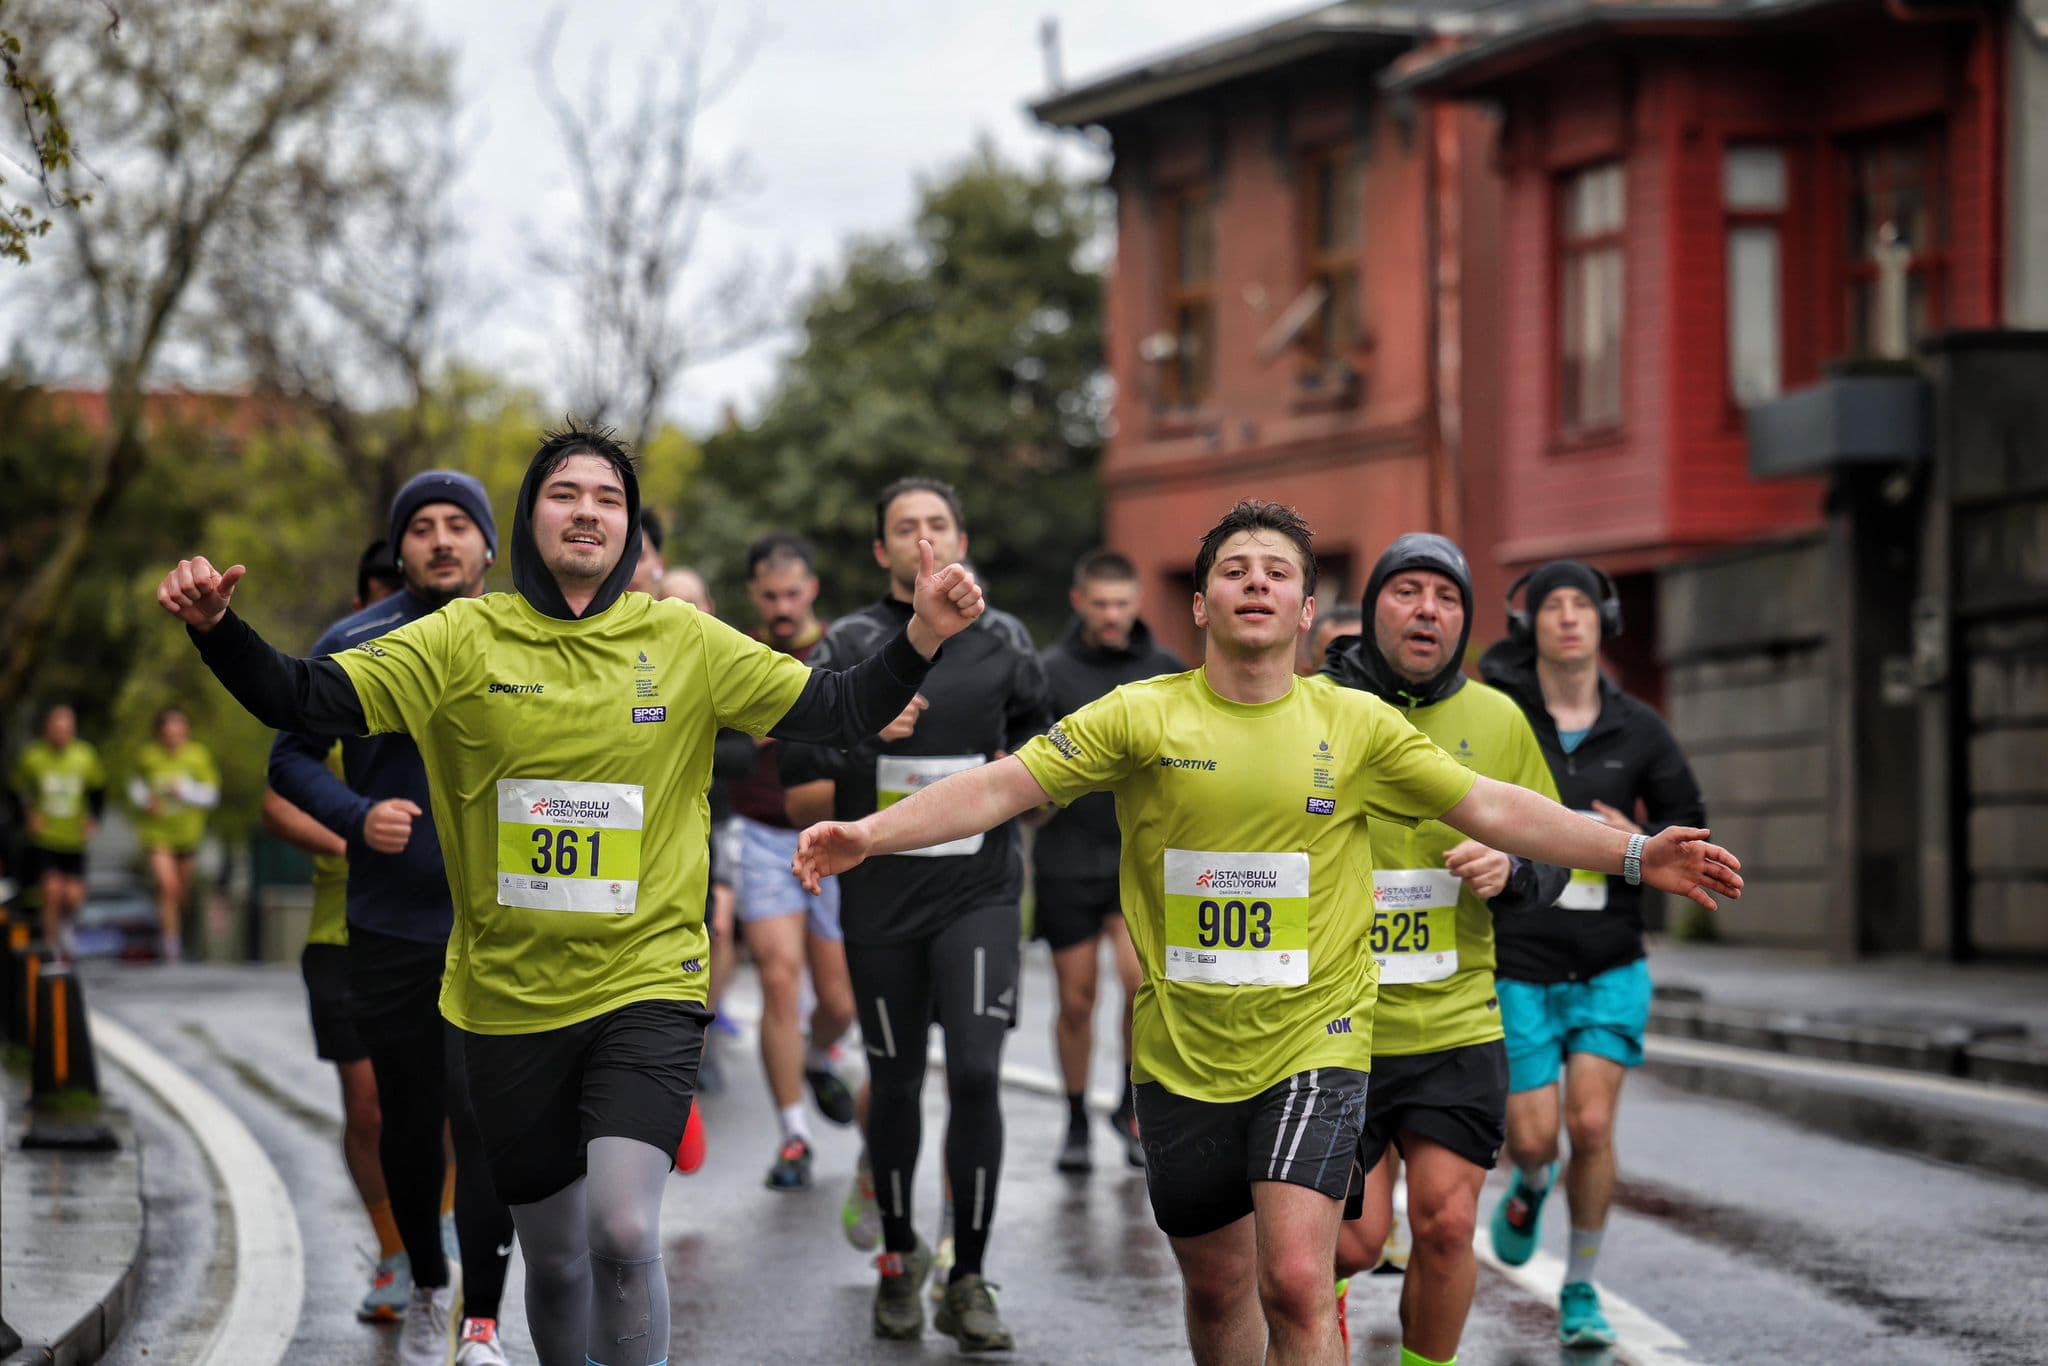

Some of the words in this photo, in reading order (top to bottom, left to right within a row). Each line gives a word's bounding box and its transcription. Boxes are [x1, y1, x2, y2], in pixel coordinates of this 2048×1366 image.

[488, 683, 544, 694] SPORTIVE
[633, 707, 664, 716] SPOR
[1160, 757, 1217, 771] SPORTIVE
[549, 798, 610, 811] İSTANBULU
[1309, 798, 1335, 809] SPOR
[531, 828, 601, 877] 361
[1214, 869, 1277, 880] İSTANBULU
[1198, 900, 1272, 949] 903
[1370, 912, 1429, 953] 525
[1326, 1017, 1352, 1035] 10K
